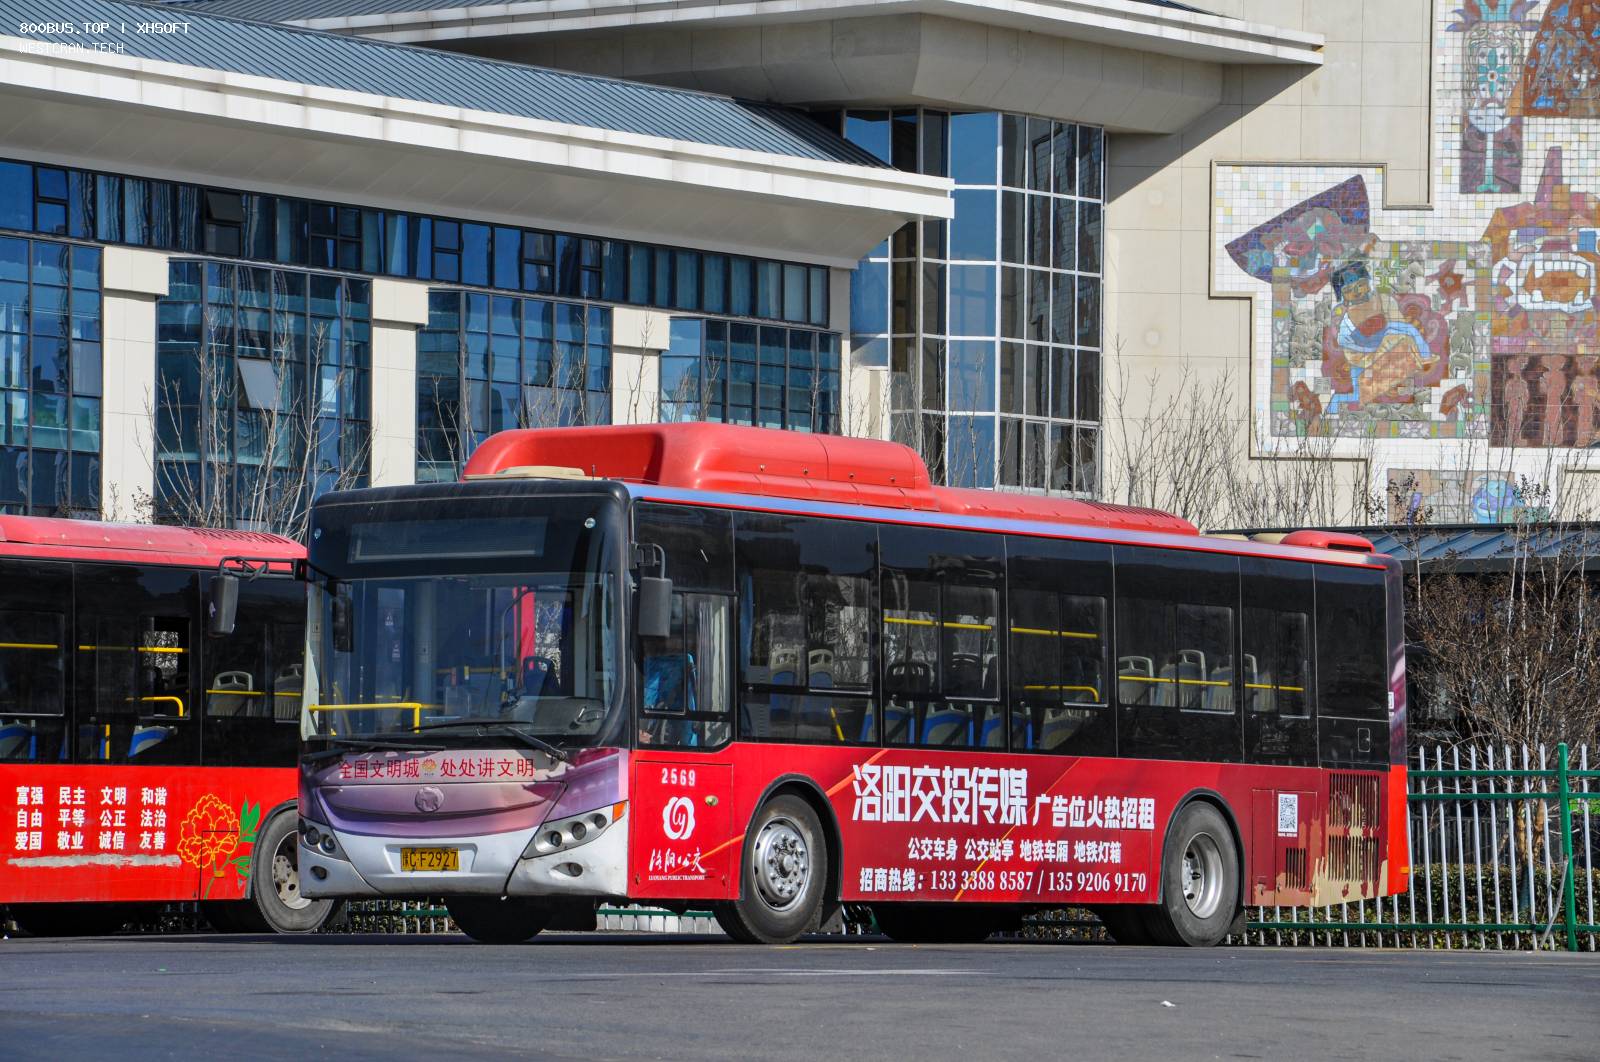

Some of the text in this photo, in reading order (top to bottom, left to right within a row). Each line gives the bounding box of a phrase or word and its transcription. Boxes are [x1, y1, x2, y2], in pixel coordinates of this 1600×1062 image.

[339, 757, 535, 779] 全国文明城 处处讲文明
[661, 767, 696, 787] 2569
[16, 786, 167, 806] 富强 民主 文明 和谐
[852, 764, 1155, 830] 洛阳交投传媒 广告位火热招租
[16, 808, 167, 828] 自由 平等 公正 法治
[15, 831, 166, 850] 爱国 敬业 诚信 友善
[908, 837, 1122, 864] 公交车身 公交站亭 地铁车厢 地铁灯箱
[930, 870, 956, 891] 133
[961, 871, 995, 891] 3388
[999, 871, 1034, 892] 8587
[1048, 872, 1073, 892] 135
[1077, 872, 1110, 893] 9206
[1114, 872, 1147, 893] 9170
